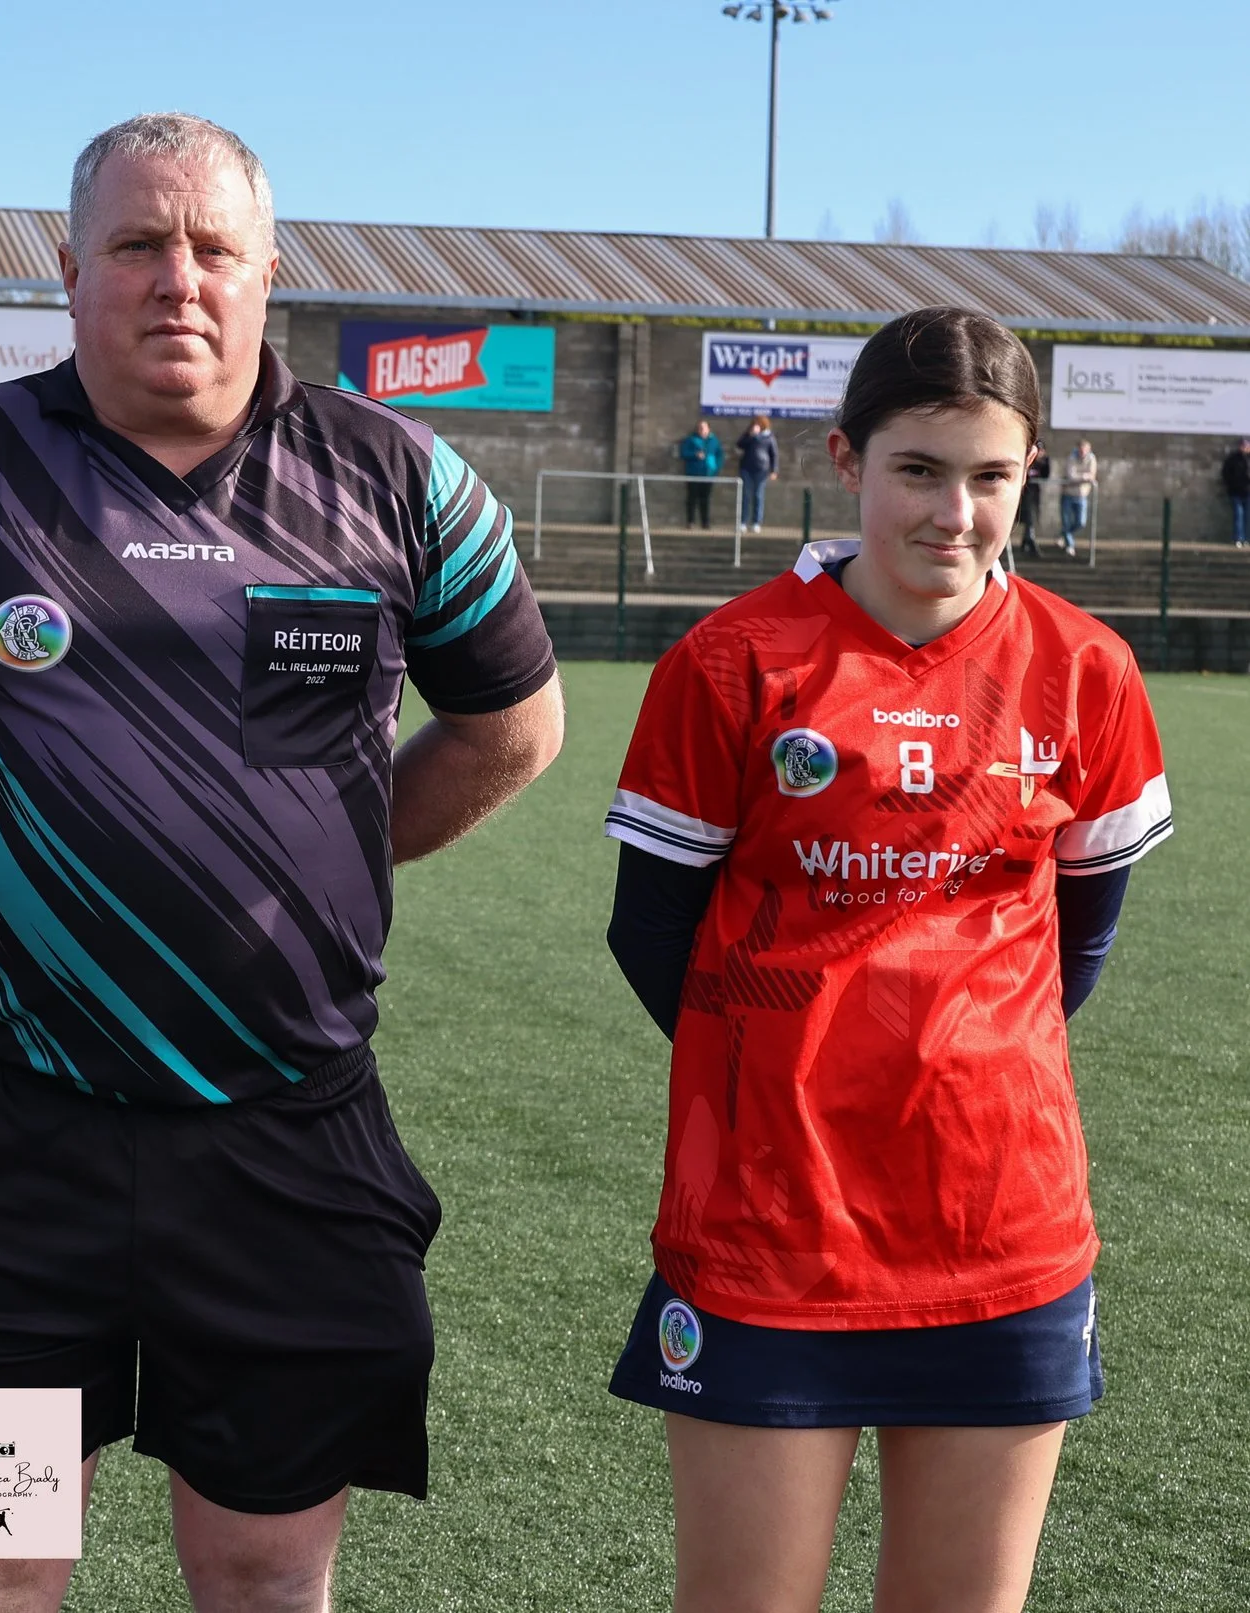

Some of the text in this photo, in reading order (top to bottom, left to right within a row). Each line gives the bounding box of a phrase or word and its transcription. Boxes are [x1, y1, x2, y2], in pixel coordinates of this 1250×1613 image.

[375, 340, 472, 393] FLAGSHIP
[712, 344, 806, 375] Wright
[274, 627, 362, 652] RÉITEOIR
[268, 661, 360, 673] ALL IRELAND FINALS
[305, 675, 326, 685] 2022
[873, 708, 960, 729] bodibro
[898, 740, 935, 794] 8
[825, 888, 886, 904] wood
[896, 887, 928, 903] for
[660, 1369, 702, 1395] bodibro
